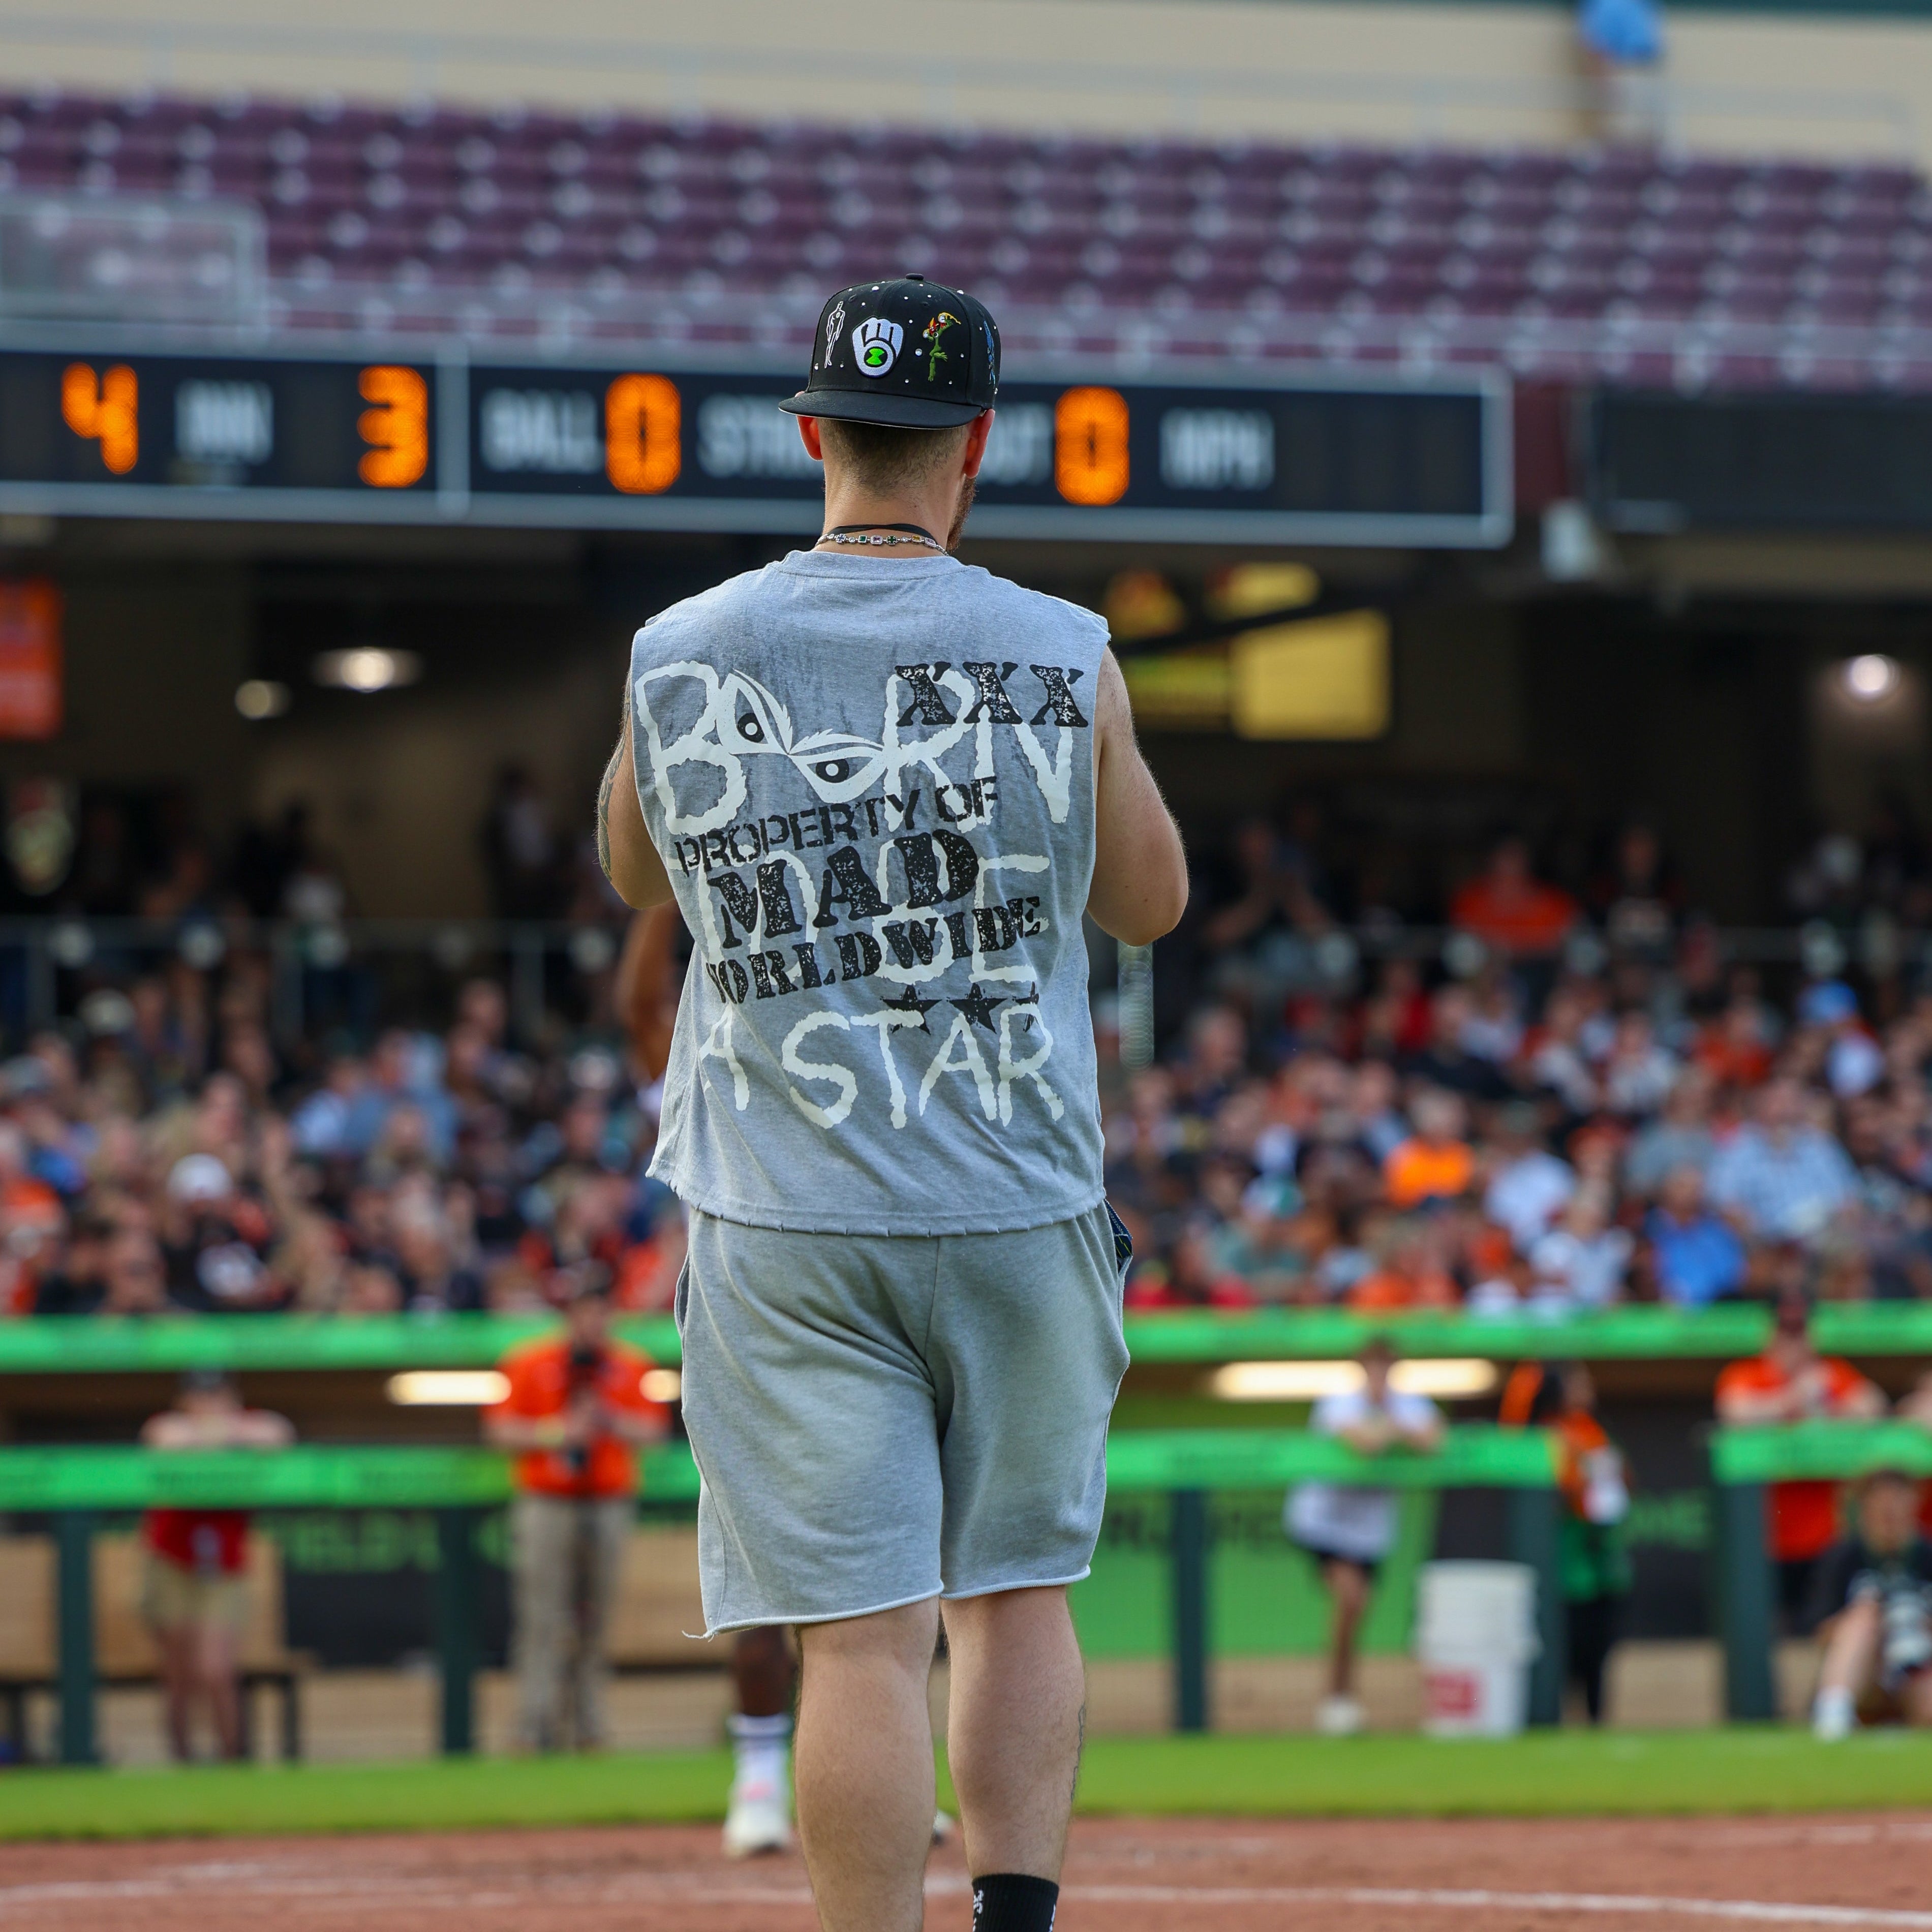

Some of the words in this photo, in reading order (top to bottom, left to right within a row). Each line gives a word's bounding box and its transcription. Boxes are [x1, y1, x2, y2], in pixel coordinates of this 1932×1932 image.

[62, 362, 138, 474] 4
[358, 365, 428, 487] 3
[605, 373, 681, 494] 0
[1055, 386, 1129, 505] 0
[894, 661, 1088, 727] XXX
[674, 789, 921, 877] PROPERTY
[935, 776, 998, 822] OF
[707, 829, 979, 948] MAD
[781, 1002, 1065, 1130] STAR
